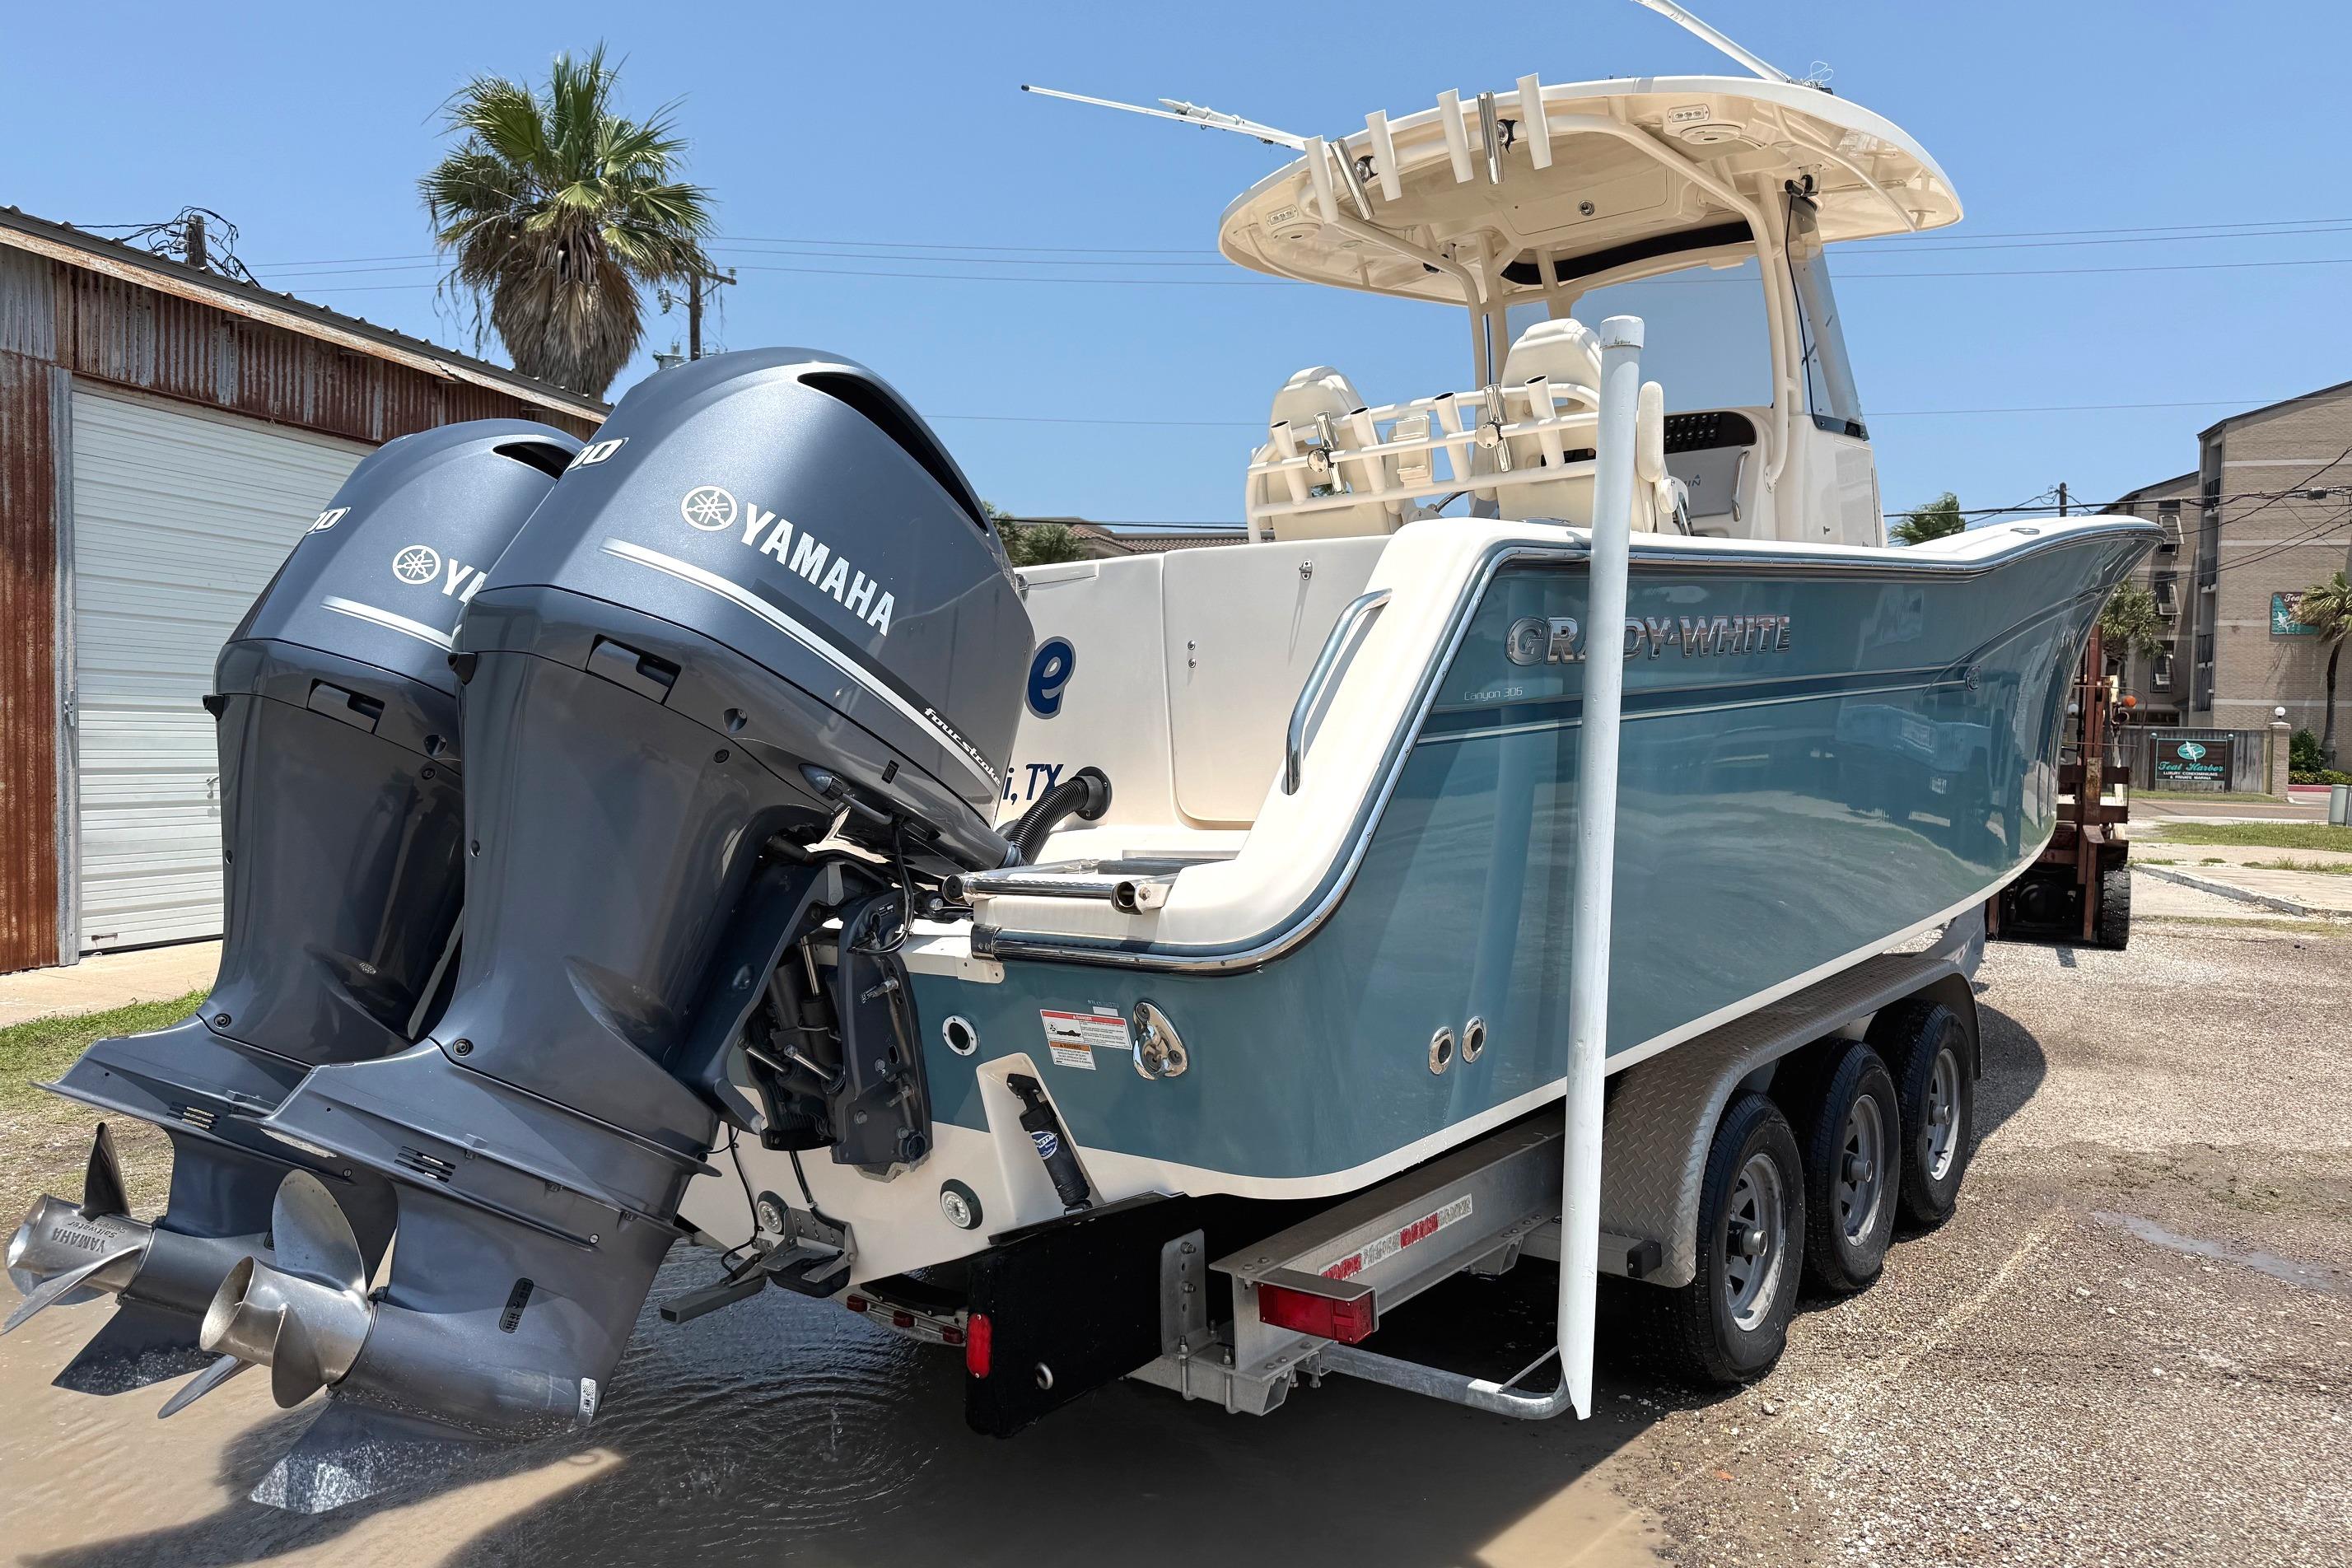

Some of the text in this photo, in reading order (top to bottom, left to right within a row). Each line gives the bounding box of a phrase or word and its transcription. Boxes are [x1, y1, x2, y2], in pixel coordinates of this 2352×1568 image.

[741, 502, 894, 637] YAMAHA
[2284, 593, 2301, 602] Tea
[1505, 615, 1790, 665] GRDY-WHITE
[1464, 687, 1523, 701] Canyon 306
[2158, 762, 2224, 772] Teal Harbor
[1026, 764, 1064, 800] TX
[52, 1228, 105, 1253] YAMAHA
[68, 1221, 117, 1239] Saltwater
